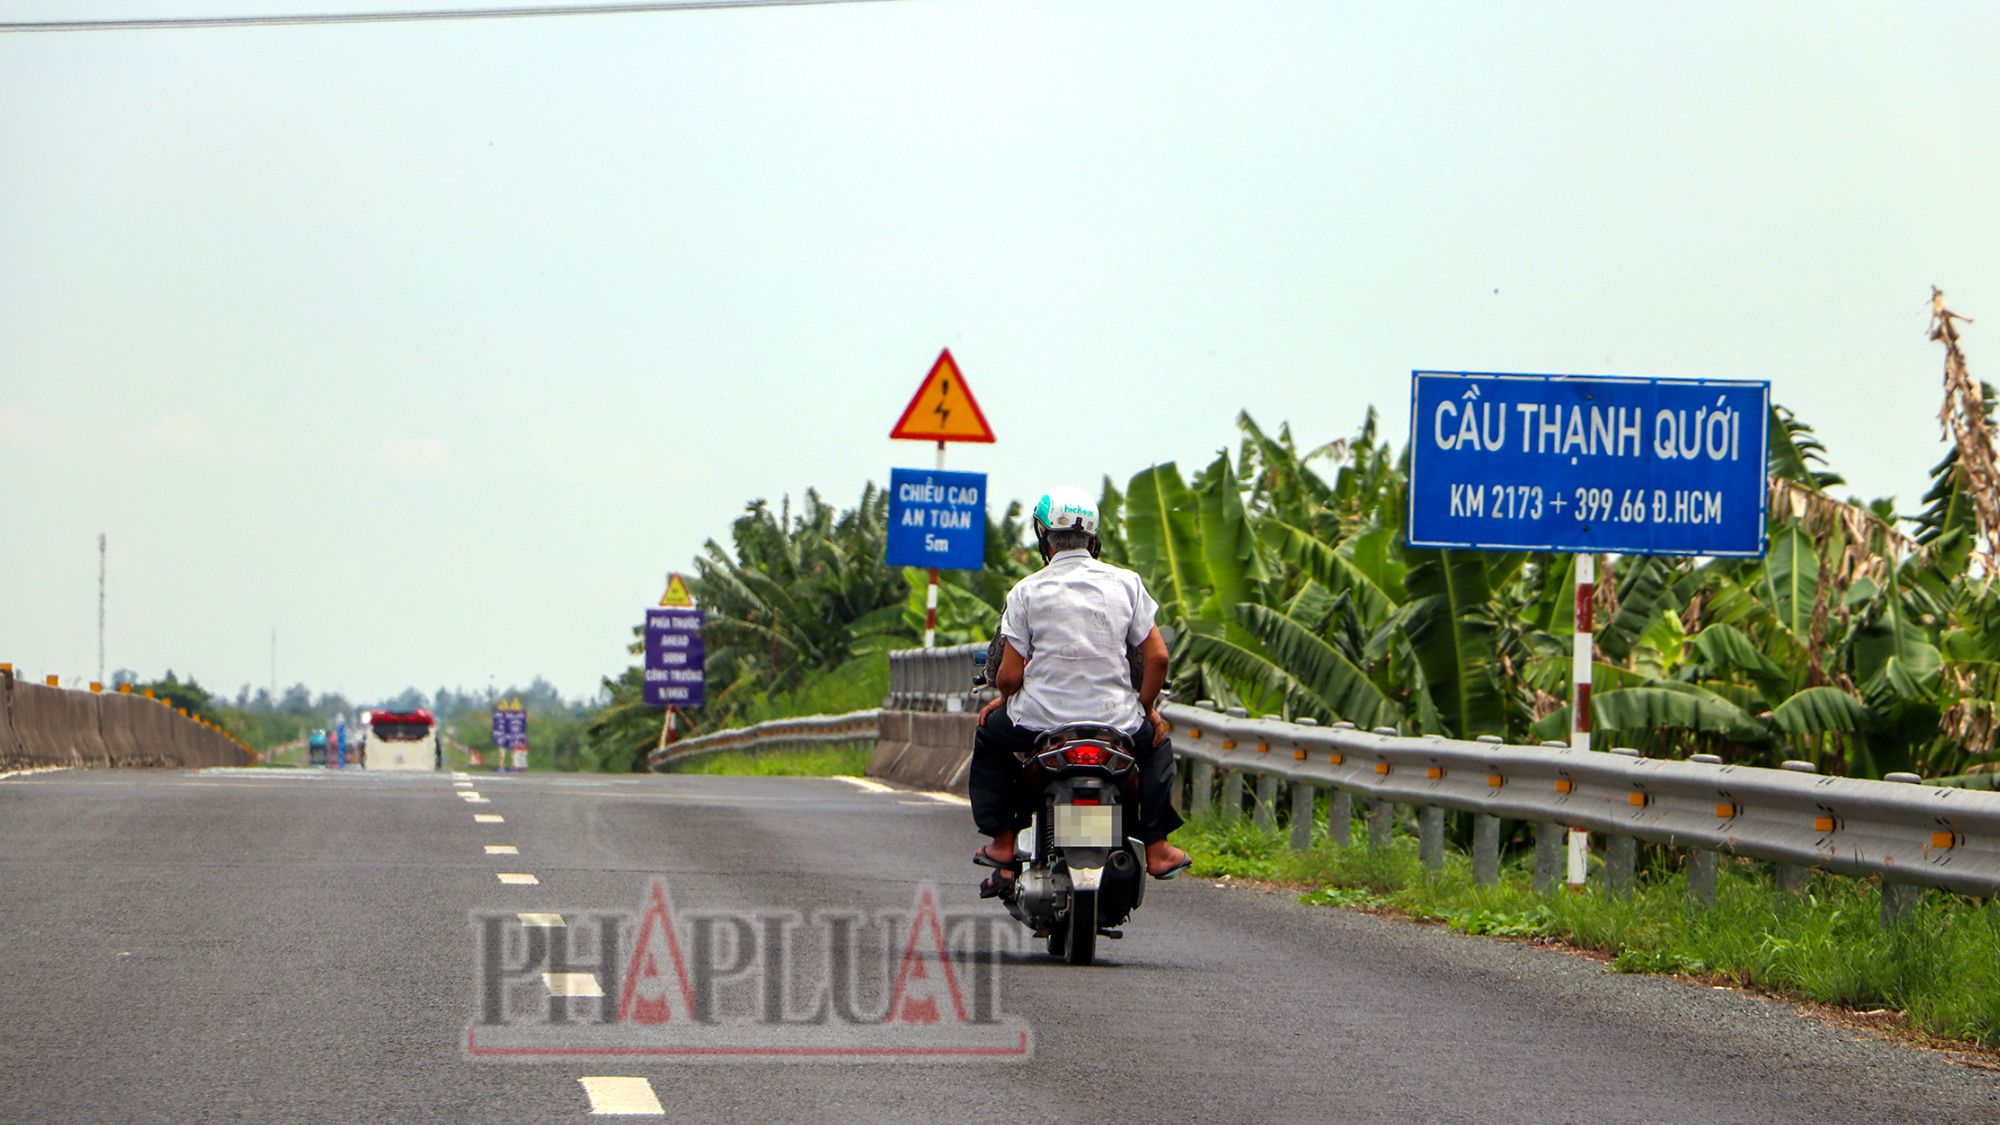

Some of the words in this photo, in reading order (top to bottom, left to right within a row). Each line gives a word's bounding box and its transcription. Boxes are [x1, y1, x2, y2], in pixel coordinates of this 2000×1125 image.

[1434, 384, 1507, 451] CẦU
[1516, 402, 1642, 466] THẠNH
[1653, 395, 1741, 462] QƯỚI
[899, 476, 945, 504] CHIỀU
[947, 485, 979, 506] CAO
[1450, 483, 1485, 518] KM
[1491, 485, 1544, 520] 2173
[1549, 491, 1568, 515] +
[1574, 486, 1646, 523] 399.66
[1652, 490, 1723, 525] Đ.HCM
[901, 507, 925, 528] AN
[930, 504, 972, 530] TOÀN
[924, 533, 949, 553] 5m
